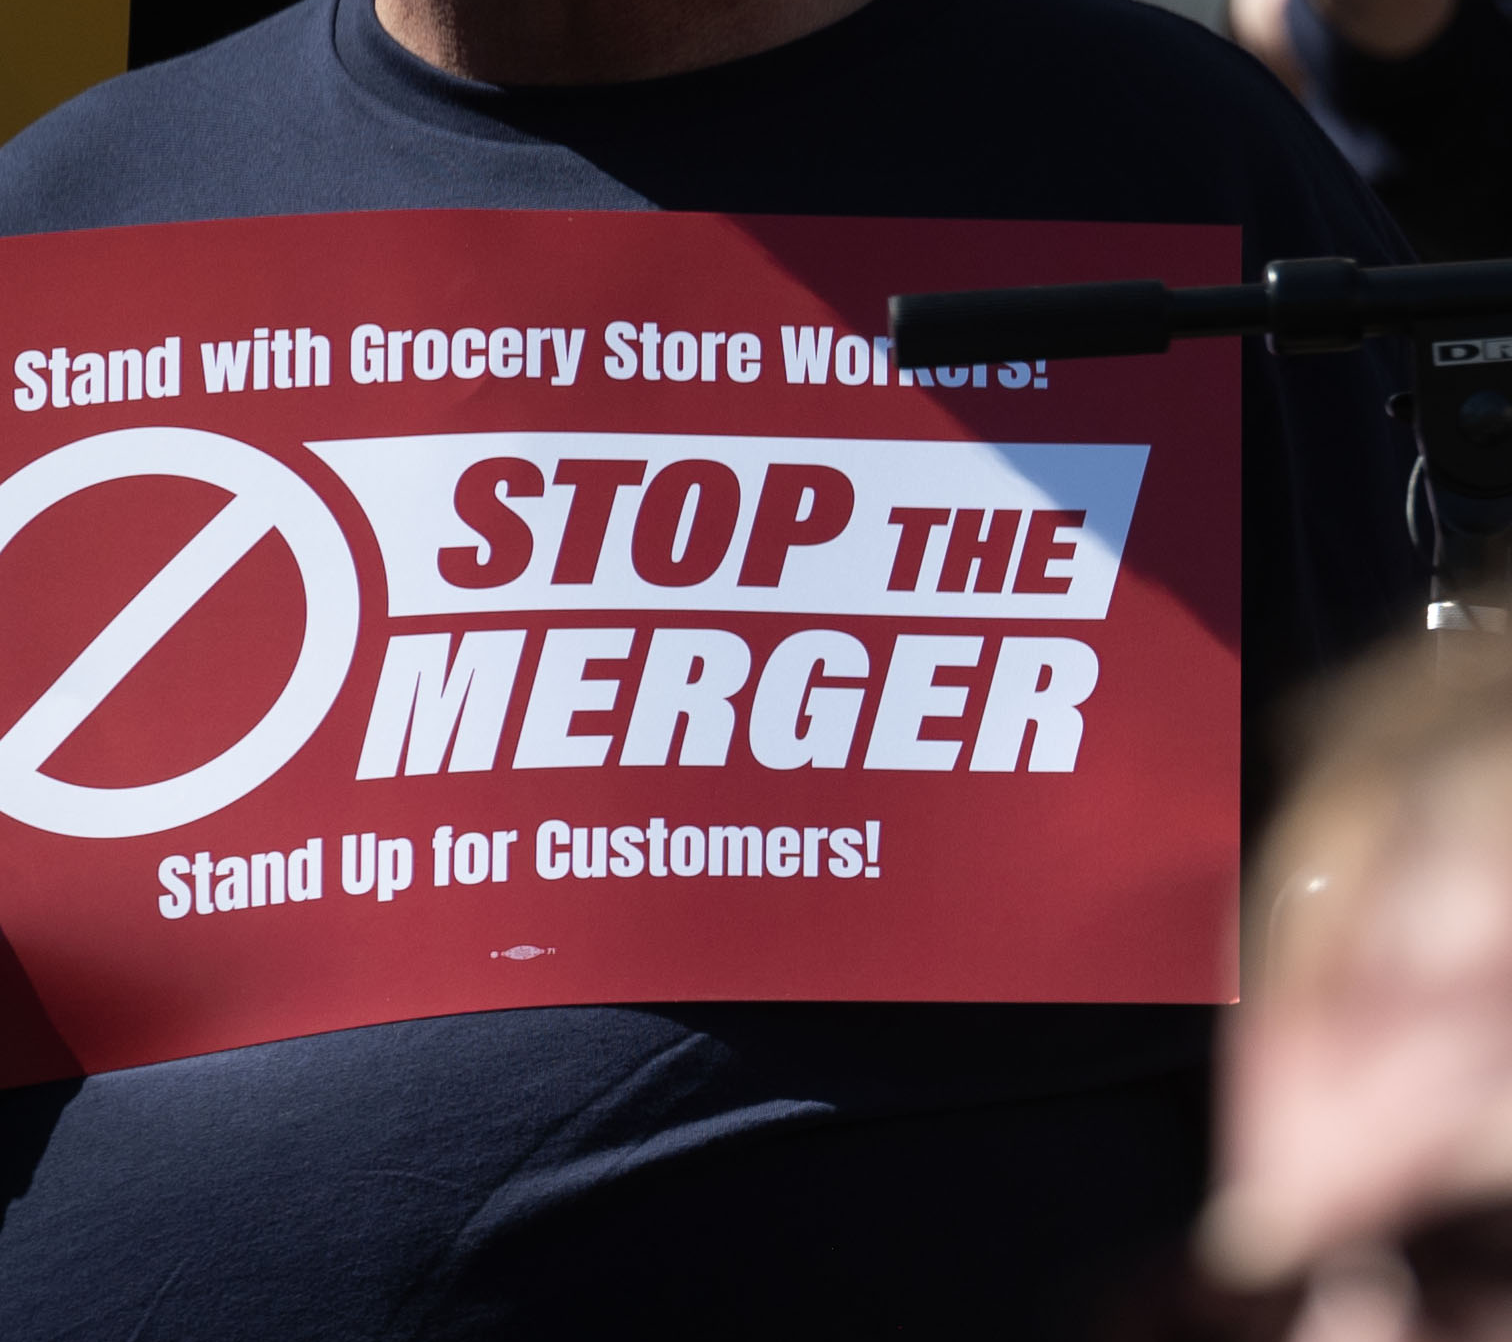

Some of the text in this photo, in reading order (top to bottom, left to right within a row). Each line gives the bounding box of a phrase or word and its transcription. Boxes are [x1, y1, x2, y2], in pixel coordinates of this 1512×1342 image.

[14, 337, 180, 412] Stand
[201, 327, 330, 394] with
[350, 323, 586, 387] Grocery
[604, 321, 761, 381] Store
[437, 457, 1085, 594] STOP THE
[355, 628, 1099, 781] MERGER
[158, 817, 880, 920] Stand Up for Customers!
